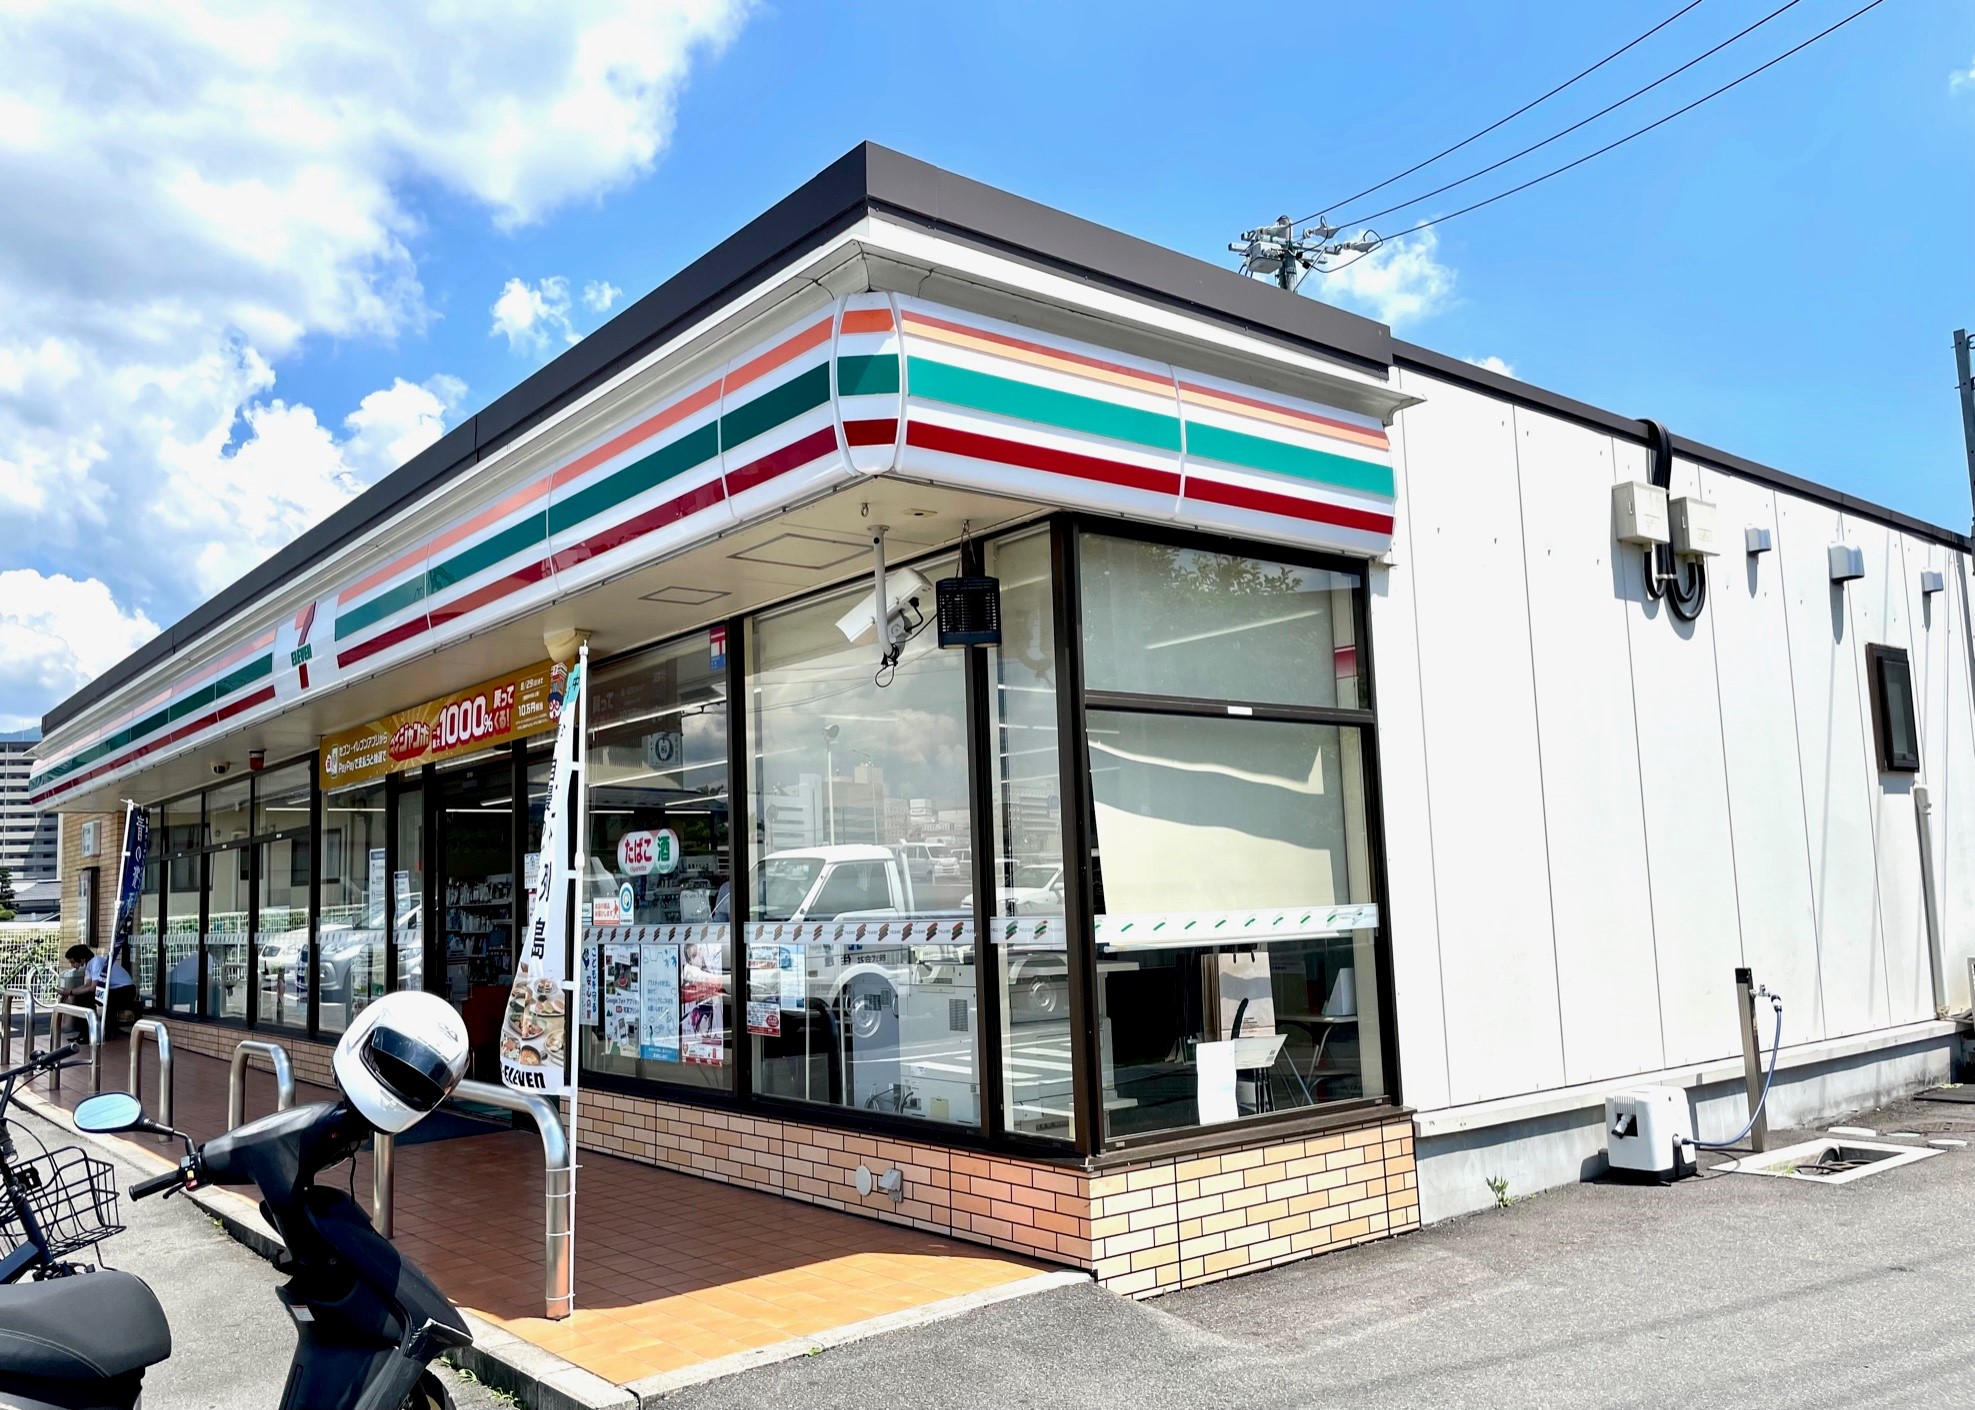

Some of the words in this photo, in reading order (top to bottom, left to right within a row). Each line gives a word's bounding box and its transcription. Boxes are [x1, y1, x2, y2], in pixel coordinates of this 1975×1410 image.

[494, 684, 515, 709] 戻って
[625, 837, 652, 863] たばこ
[657, 836, 670, 861] 酒
[500, 1062, 546, 1089] -ELEVEn
